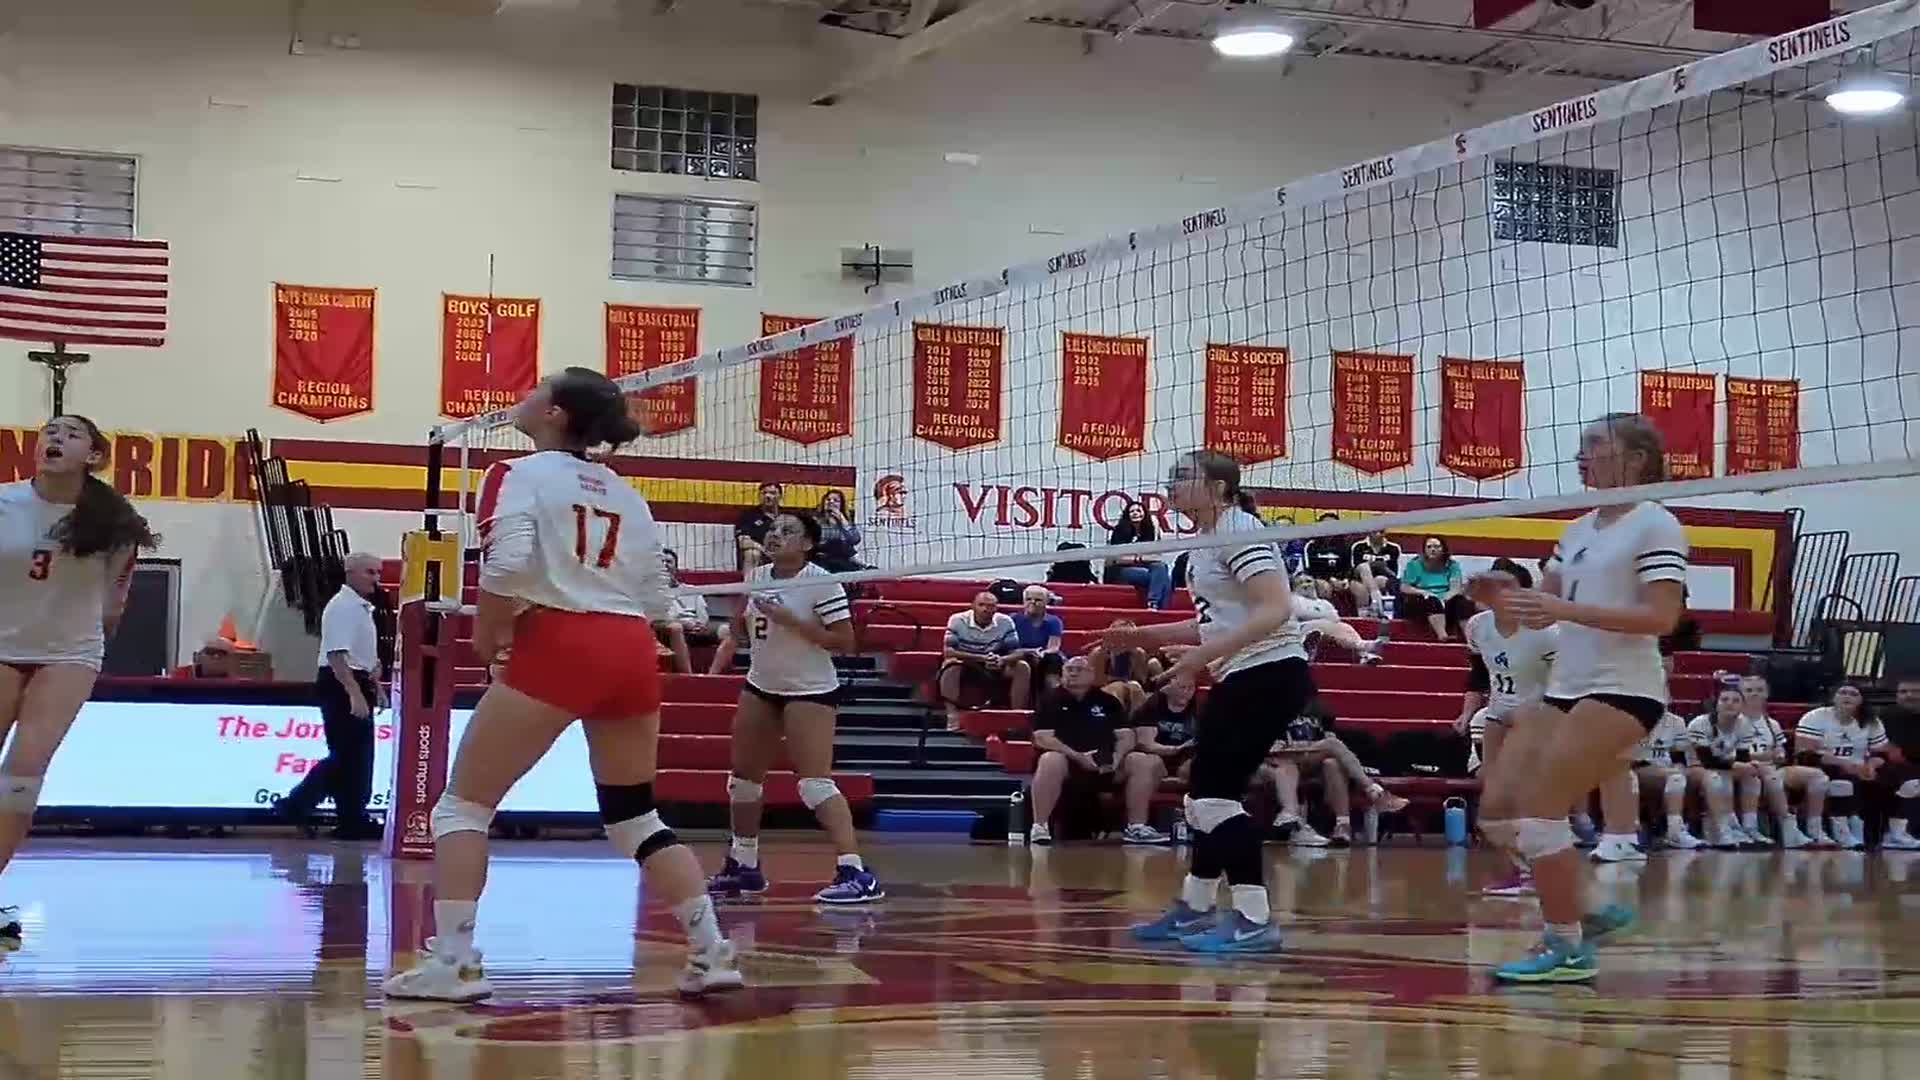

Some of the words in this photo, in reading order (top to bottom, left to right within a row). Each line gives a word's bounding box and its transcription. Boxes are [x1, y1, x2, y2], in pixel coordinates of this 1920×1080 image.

[1768, 21, 1850, 63] SENTINELS
[1533, 97, 1597, 132] SENTINELS
[1342, 157, 1393, 188] SENTINELS
[448, 300, 489, 316] BOYS
[496, 303, 536, 317] GOLF
[288, 330, 318, 341] 2020
[1207, 348, 1239, 364] GIRLS
[1243, 351, 1284, 365] SOCCER
[297, 380, 350, 396] REGION
[464, 389, 516, 402] REGION
[925, 386, 950, 396] 2017
[278, 391, 369, 410] CHAMPIONS
[780, 407, 828, 420] REGION
[933, 413, 980, 426] REGION
[762, 418, 843, 433] CHAMPIONS
[916, 424, 995, 438] CHAMPIONS
[1082, 423, 1126, 436] REGION
[1064, 433, 1140, 449] CHAMPIONS
[1222, 430, 1267, 443] REGION
[1353, 438, 1395, 450] REGION
[1336, 447, 1409, 462] CHAMPIONS
[1461, 445, 1500, 456] REGION
[572, 503, 621, 569] 17
[29, 548, 53, 581] 3
[218, 715, 269, 738] The
[418, 725, 431, 760] sports
[415, 761, 429, 804] imports
